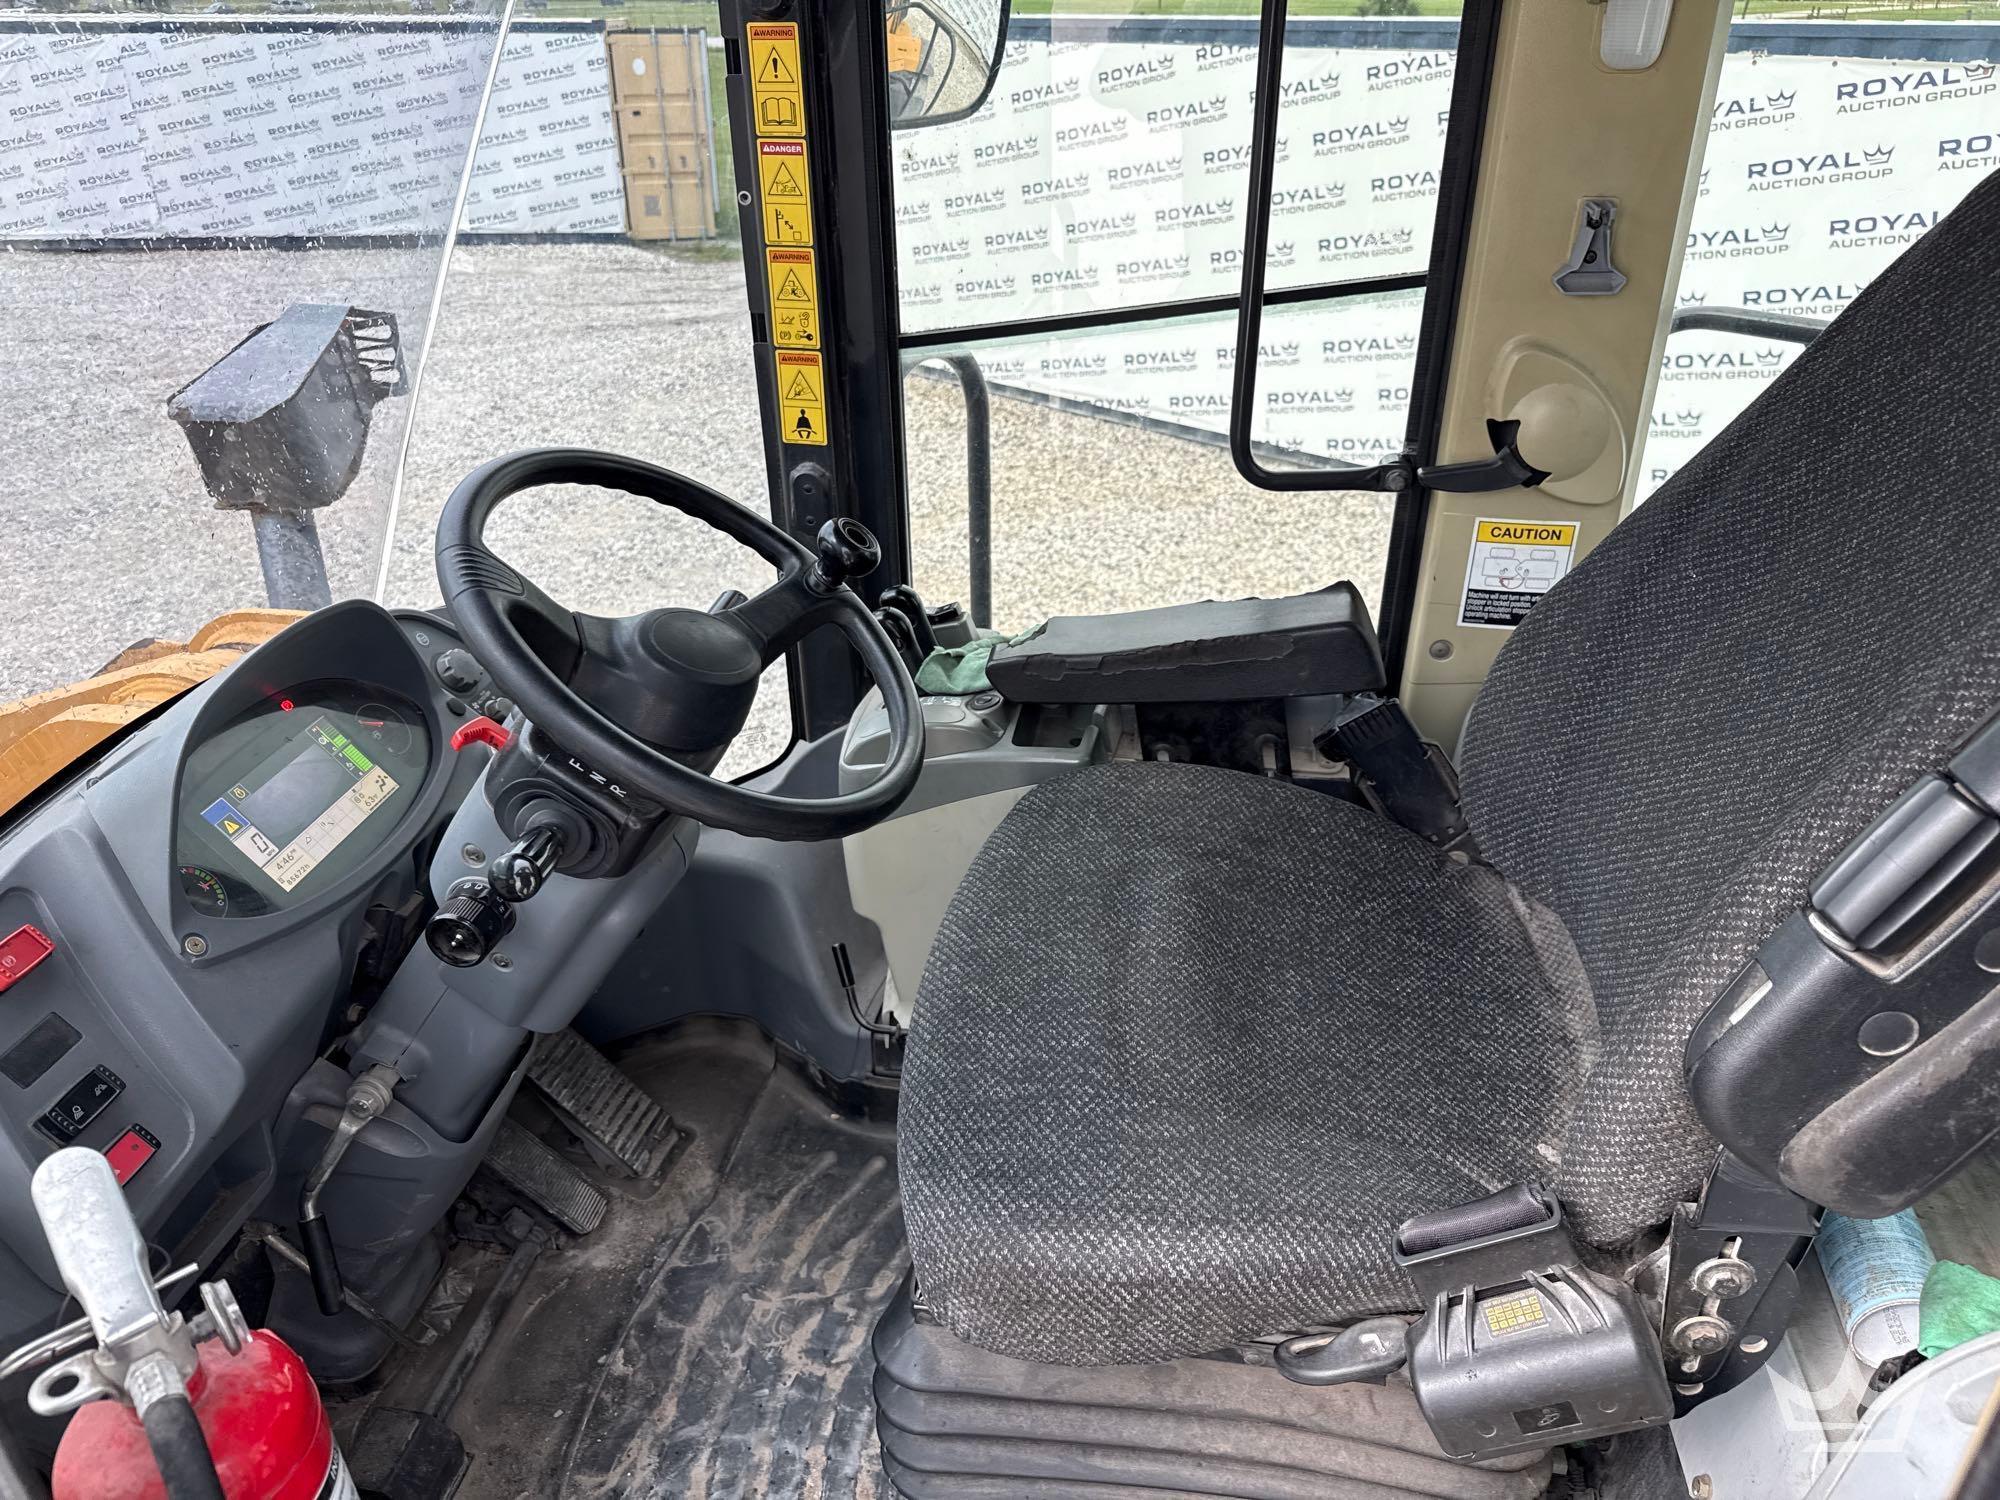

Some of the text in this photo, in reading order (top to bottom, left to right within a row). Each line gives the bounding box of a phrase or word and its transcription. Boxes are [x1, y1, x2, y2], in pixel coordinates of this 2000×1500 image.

[545, 33, 586, 48] ROYAL
[760, 29, 793, 37] WARNING
[267, 35, 310, 51] ROYAL
[202, 49, 244, 64] ROYAL
[311, 54, 355, 70] ROYAL
[1197, 56, 1242, 72] AUCTION
[136, 64, 179, 79] ROYAL
[523, 66, 563, 81] ROYAL
[1098, 61, 1157, 84] ROYAL
[1366, 53, 1448, 81] ROYAL
[31, 68, 73, 82] ROYAL
[246, 69, 288, 84] ROYAL
[1100, 71, 1176, 94] AUCTION GROUP
[1367, 75, 1423, 93] AUCTION
[1836, 68, 1960, 101] ROYAL
[74, 87, 114, 102] ROYAL
[561, 85, 601, 100] ROYAL
[1011, 83, 1064, 104] ROYAL
[1300, 90, 1341, 105] GROUP
[1836, 83, 1998, 115] AUCTION GROUP
[9, 101, 50, 116] ROYAL
[497, 99, 537, 113] ROYAL
[1147, 102, 1208, 124] ROYAL
[55, 120, 97, 135] ROYAL
[158, 115, 200, 131] ROYAL
[268, 120, 310, 135] ROYAL
[539, 117, 579, 131] ROYAL
[1149, 120, 1191, 134] AUCTION
[1735, 112, 1796, 129] GROUP
[1056, 122, 1112, 143] ROYAL
[1312, 121, 1388, 147] ROYAL
[96, 140, 139, 154] ROYAL
[770, 145, 802, 153] DANGER
[974, 139, 1024, 159] ROYAL
[1314, 134, 1410, 158] AUCTION GROUP
[34, 154, 73, 168] ROYAL
[513, 150, 553, 163] ROYAL
[902, 155, 946, 174] ROYAL
[1108, 160, 1166, 181] ROYAL
[1205, 161, 1248, 175] AUCTION
[1747, 152, 1861, 179] ROYAL
[79, 172, 120, 186] ROYAL
[181, 168, 221, 181] ROYAL
[554, 168, 594, 181] ROYAL
[1747, 168, 1894, 193] AUCTION GROUP
[16, 186, 56, 200] ROYAL
[224, 187, 265, 199] ROYAL
[493, 181, 531, 194] ROYAL
[1022, 177, 1074, 196] ROYAL
[944, 192, 991, 210] ROYAL
[1372, 188, 1423, 204] AUCTION
[57, 203, 97, 219] ROYAL
[529, 200, 568, 212] ROYAL
[1155, 203, 1216, 223] ROYAL
[1307, 199, 1347, 213] GROUP
[202, 218, 241, 231] ROYAL
[1066, 217, 1120, 235] ROYAL
[984, 230, 1034, 247] ROYAL
[1828, 233, 1911, 249] AUCTION
[912, 239, 957, 257] ROYAL
[1319, 244, 1414, 263] AUCTION GROUP
[1730, 244, 1790, 258] GROUP
[778, 253, 809, 261] WARNING
[1116, 258, 1174, 275] ROYAL
[1031, 269, 1083, 286] ROYAL
[955, 279, 1002, 294] ROYAL
[1743, 284, 1853, 306] ROYAL
[1322, 338, 1395, 354] ROYAL
[786, 355, 817, 363] WARNING
[1040, 357, 1084, 371] ROYAL
[1124, 351, 1181, 366] ROYAL
[1324, 351, 1416, 364] AUCTION GROUP
[1726, 369, 1783, 380] GROUP
[1169, 396, 1228, 408] ROYAL
[1266, 391, 1335, 406] ROYAL
[1649, 429, 1702, 438] GROUP
[1326, 438, 1396, 452] ROYAL
[1490, 526, 1562, 541] CAUTION
[1468, 591, 1489, 599] Machine
[569, 758, 585, 772] F
[589, 771, 607, 785] N
[609, 784, 627, 798] R
